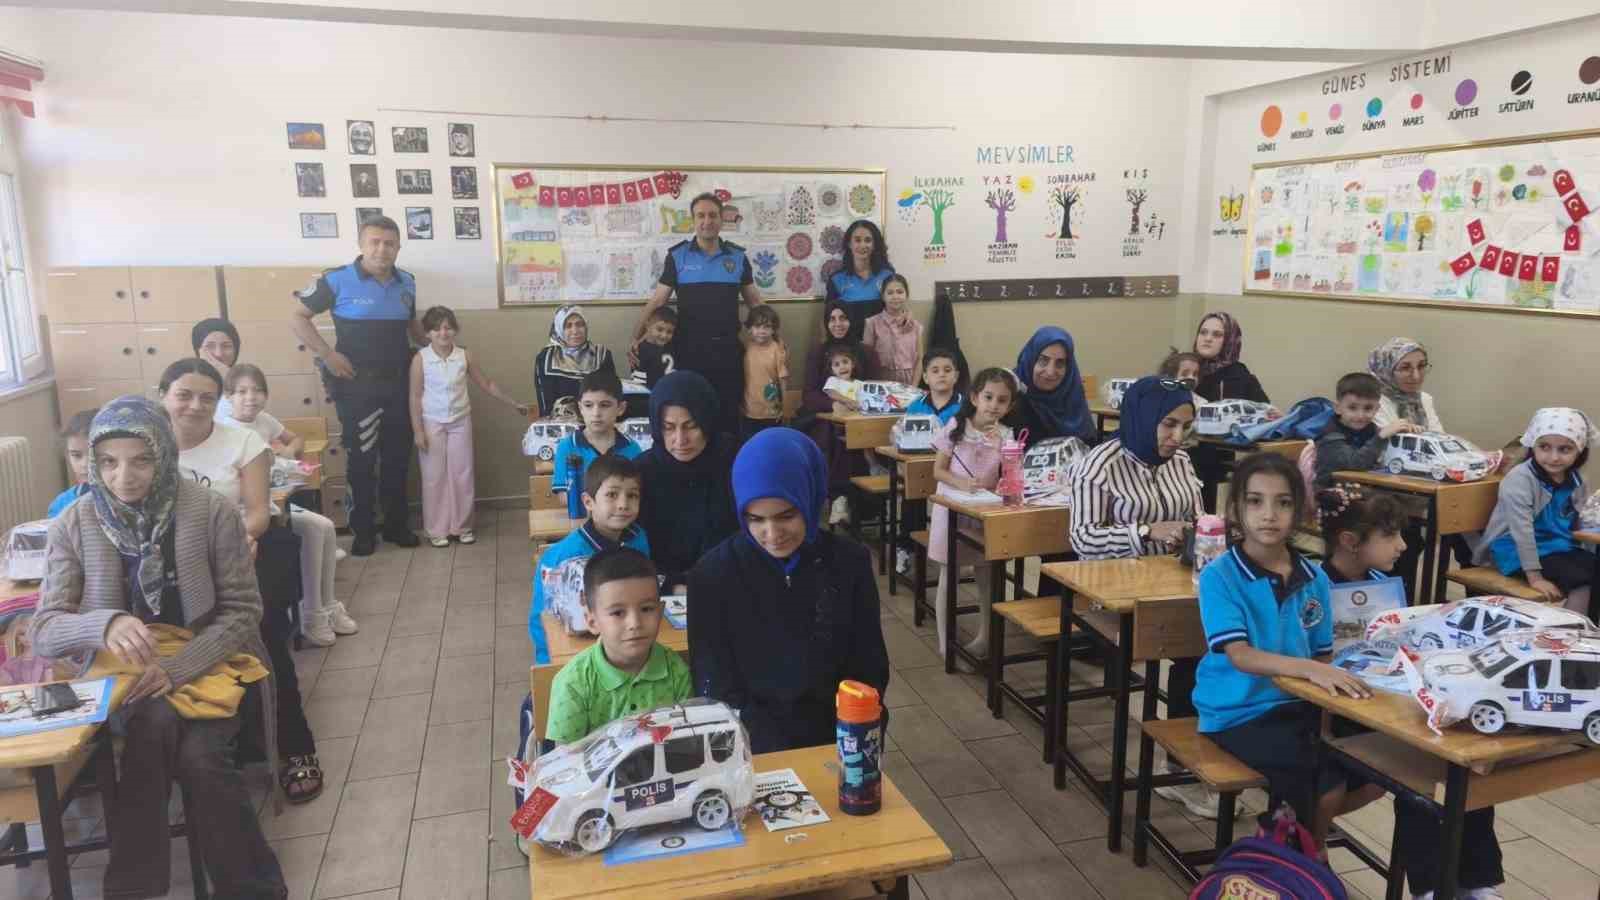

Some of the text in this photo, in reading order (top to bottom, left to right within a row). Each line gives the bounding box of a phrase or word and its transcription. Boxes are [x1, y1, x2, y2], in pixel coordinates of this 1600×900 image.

[1567, 88, 1600, 104] URANÜ
[1402, 116, 1425, 127] MARS
[977, 144, 1074, 165] MEVSİMLER
[983, 175, 1013, 185] YAZ
